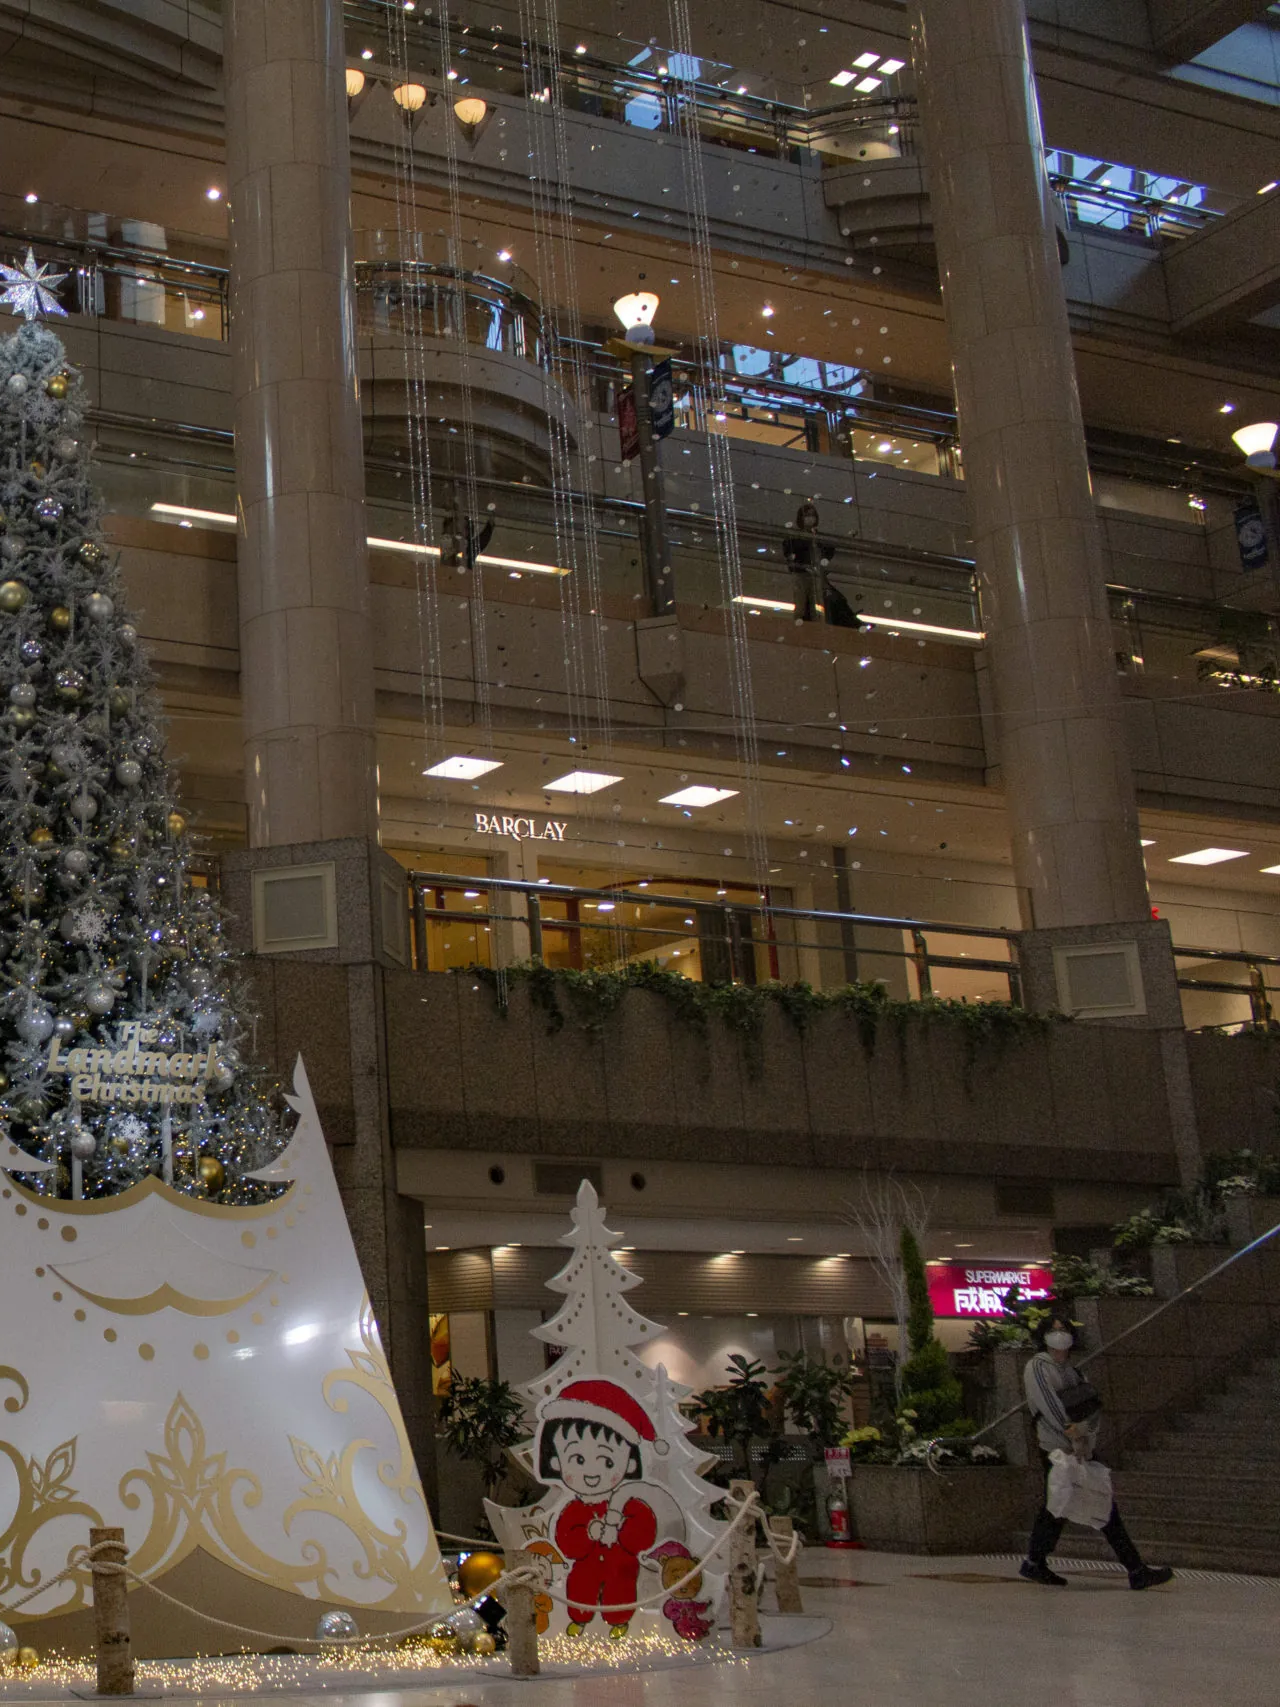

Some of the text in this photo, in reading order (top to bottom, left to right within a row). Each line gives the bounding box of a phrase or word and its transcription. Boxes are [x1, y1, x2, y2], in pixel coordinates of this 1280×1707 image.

[475, 813, 568, 841] BARCLAY
[120, 1021, 159, 1043] The
[47, 1038, 225, 1080] Landmark
[71, 1073, 207, 1103] Christmas
[965, 1269, 1031, 1284] SUPERMARKET
[953, 1286, 1048, 1314] 成城
